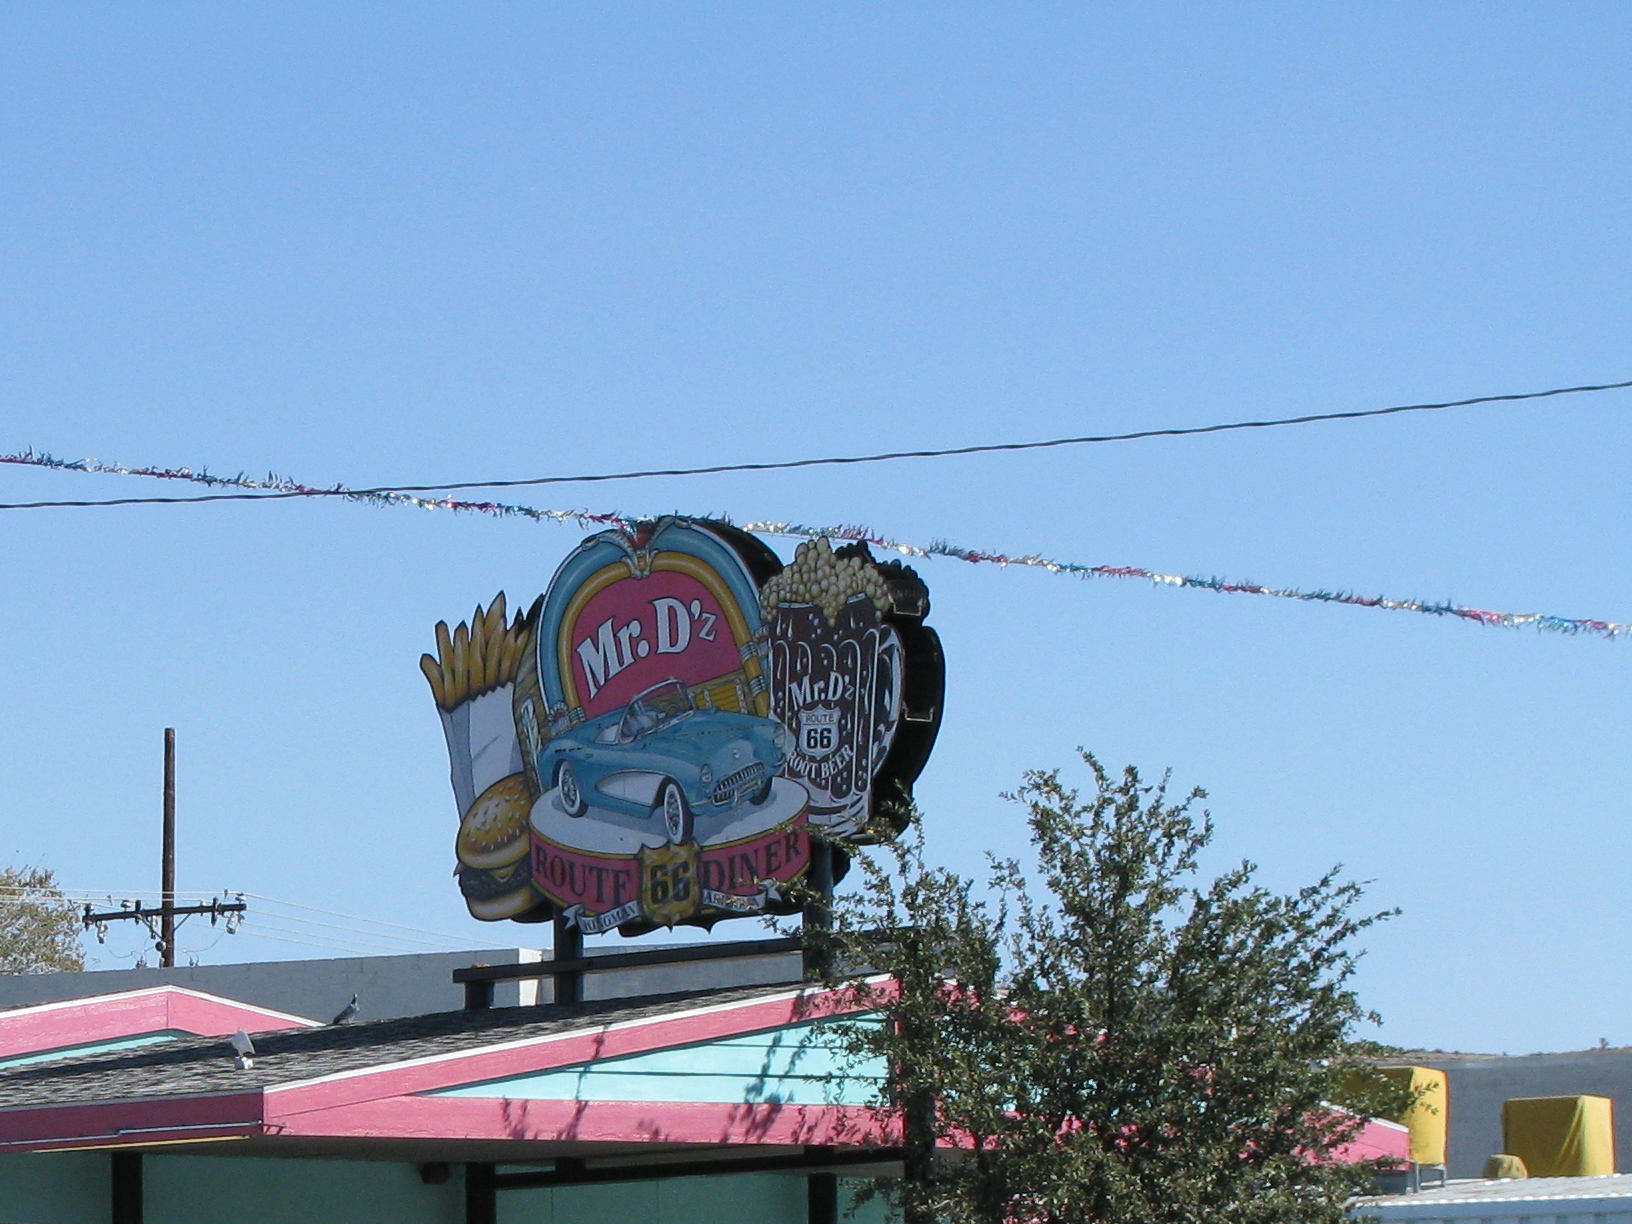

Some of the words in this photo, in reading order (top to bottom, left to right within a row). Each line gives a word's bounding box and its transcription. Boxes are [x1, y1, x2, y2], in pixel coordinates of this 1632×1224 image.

[576, 616, 650, 701] Mr.
[649, 597, 717, 655] D'z
[789, 674, 826, 711] Mr.
[827, 671, 855, 701] D'z
[805, 713, 835, 723] ROUTE
[806, 728, 832, 749] 66
[789, 751, 819, 779] ROOT
[821, 744, 854, 779] BEER
[535, 844, 631, 906] ROUTE
[650, 860, 691, 906] 66
[703, 830, 802, 892] DINER
[583, 901, 638, 931] KINGMAN
